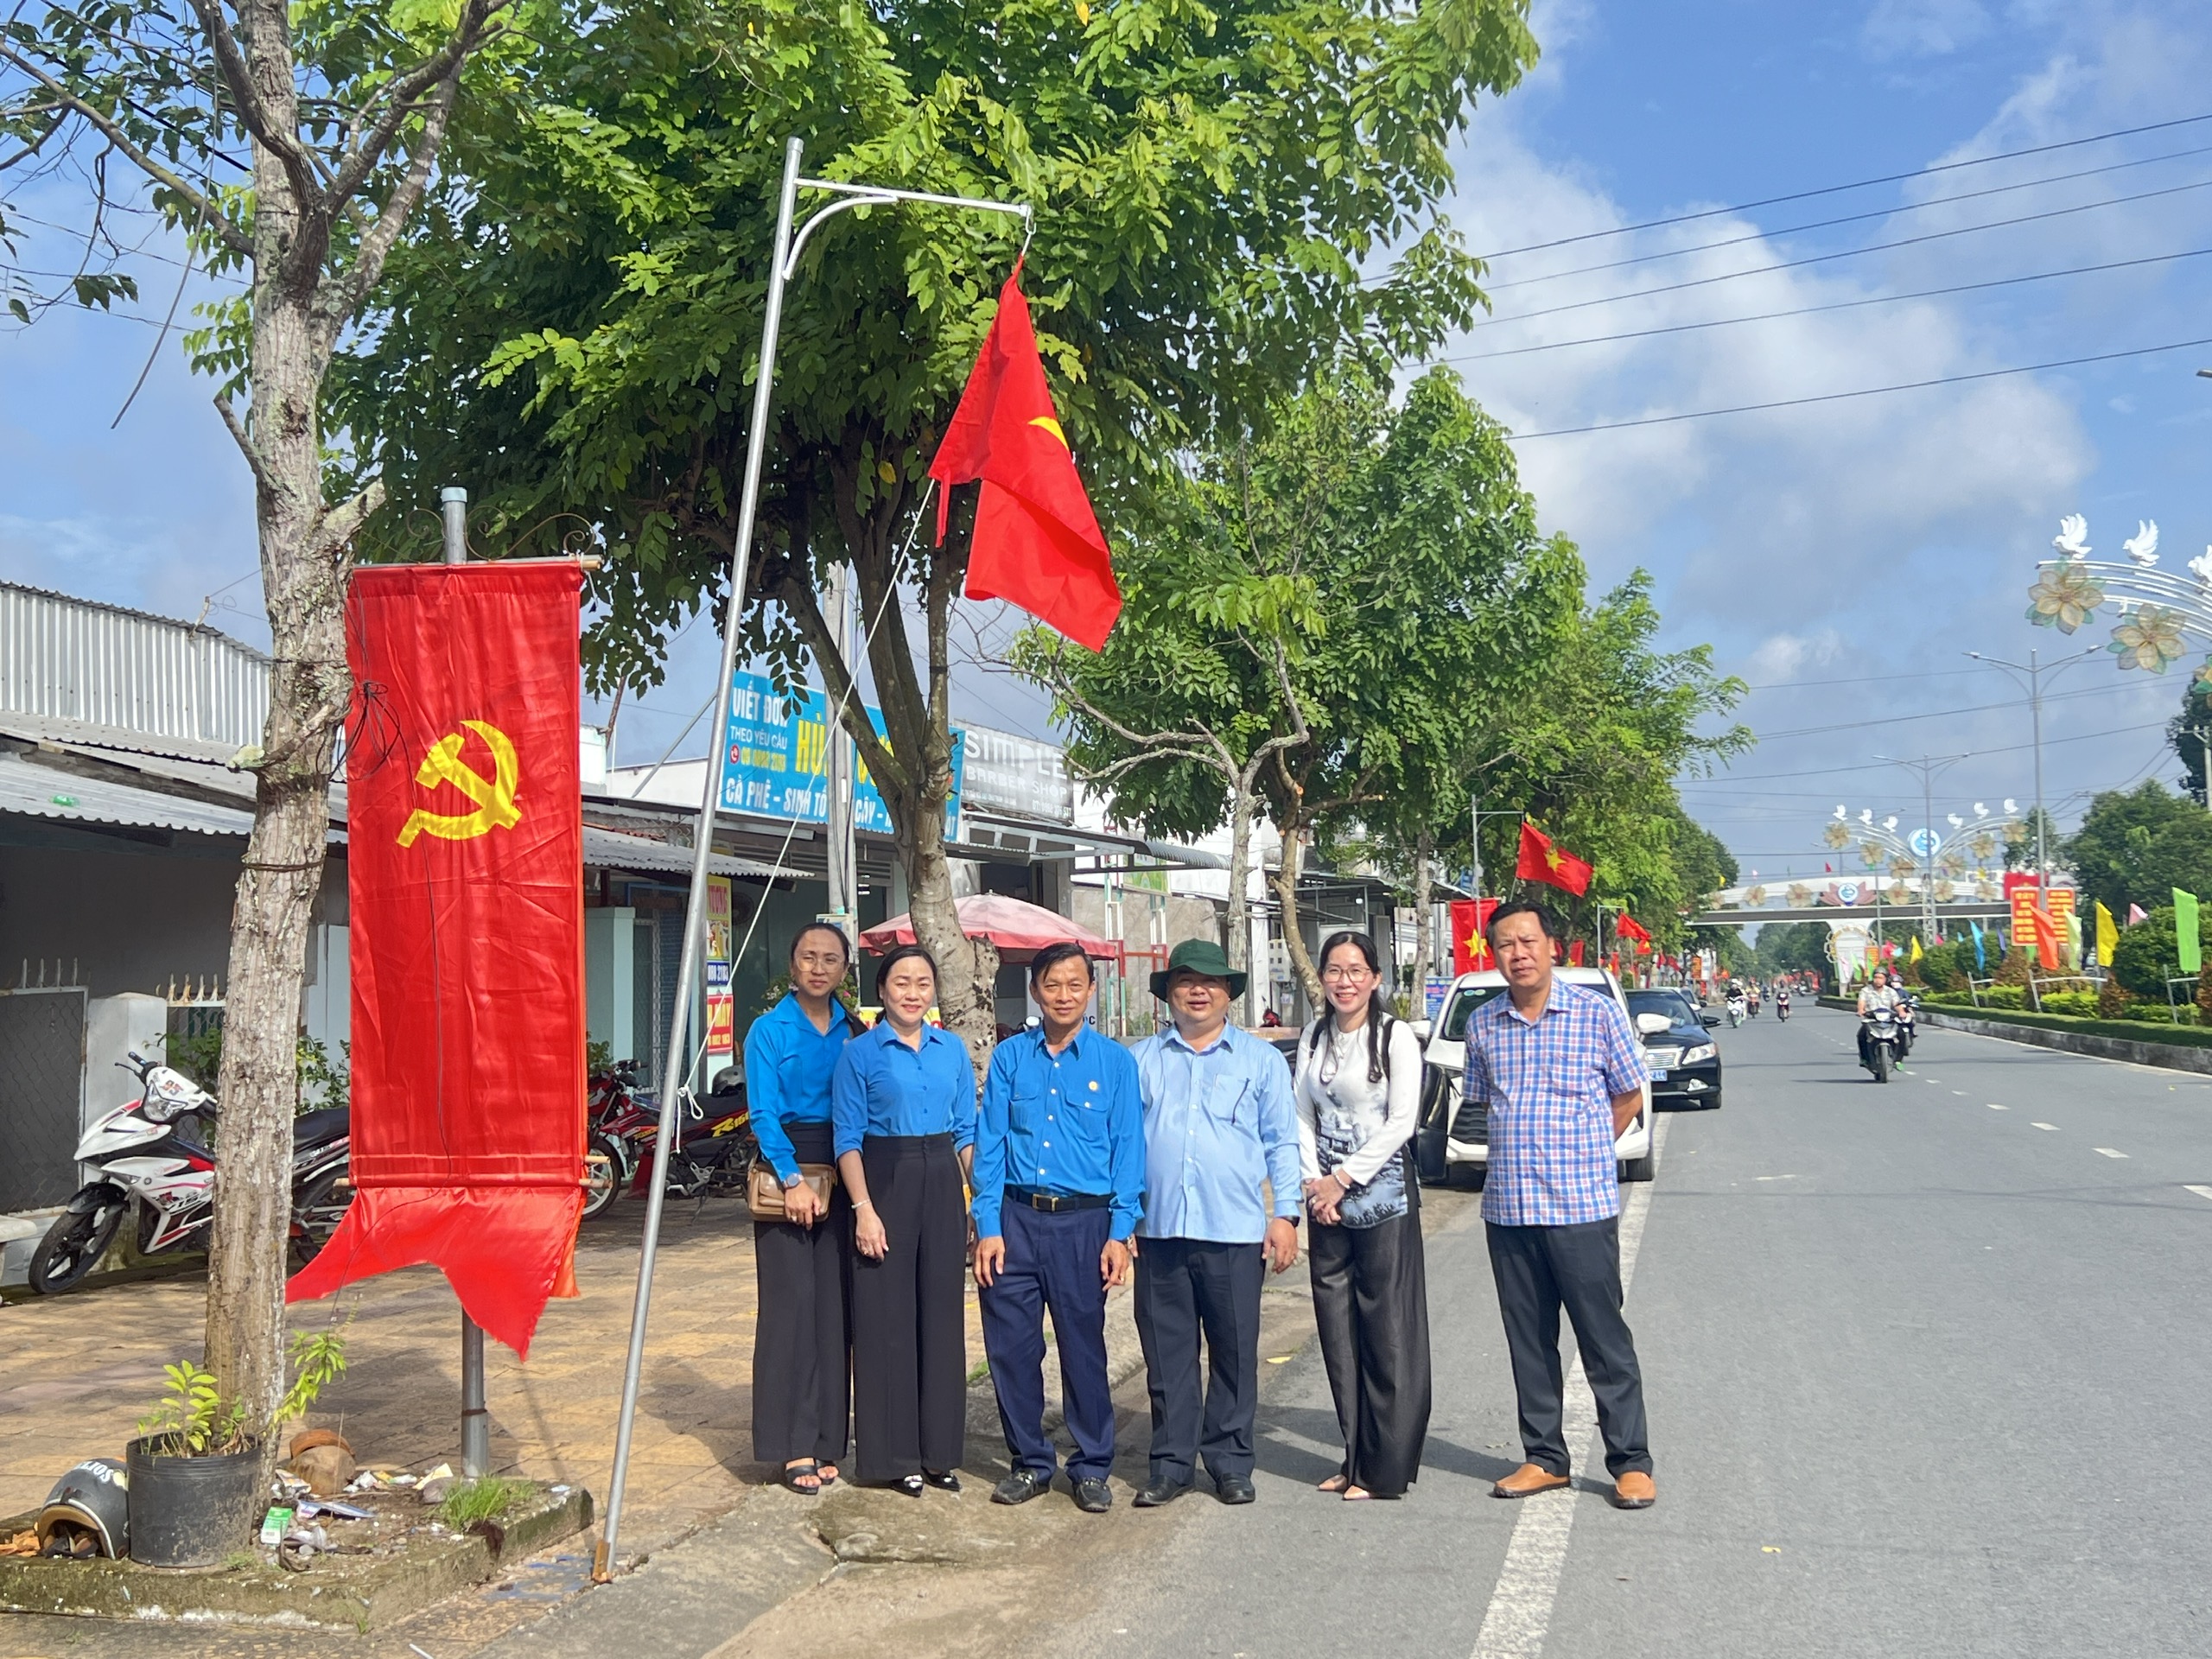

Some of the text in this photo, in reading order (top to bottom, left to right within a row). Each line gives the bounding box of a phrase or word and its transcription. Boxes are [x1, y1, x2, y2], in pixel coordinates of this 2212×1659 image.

[733, 680, 760, 721] VIẾT
[730, 725, 753, 743] THEO
[754, 728, 770, 747] YÊU
[726, 773, 743, 805] CÀ
[746, 779, 772, 810] PHÊ
[783, 787, 812, 816] SINH
[966, 765, 1026, 791] BARBER
[1032, 780, 1068, 799] SHOP
[855, 796, 876, 825] CÂY
